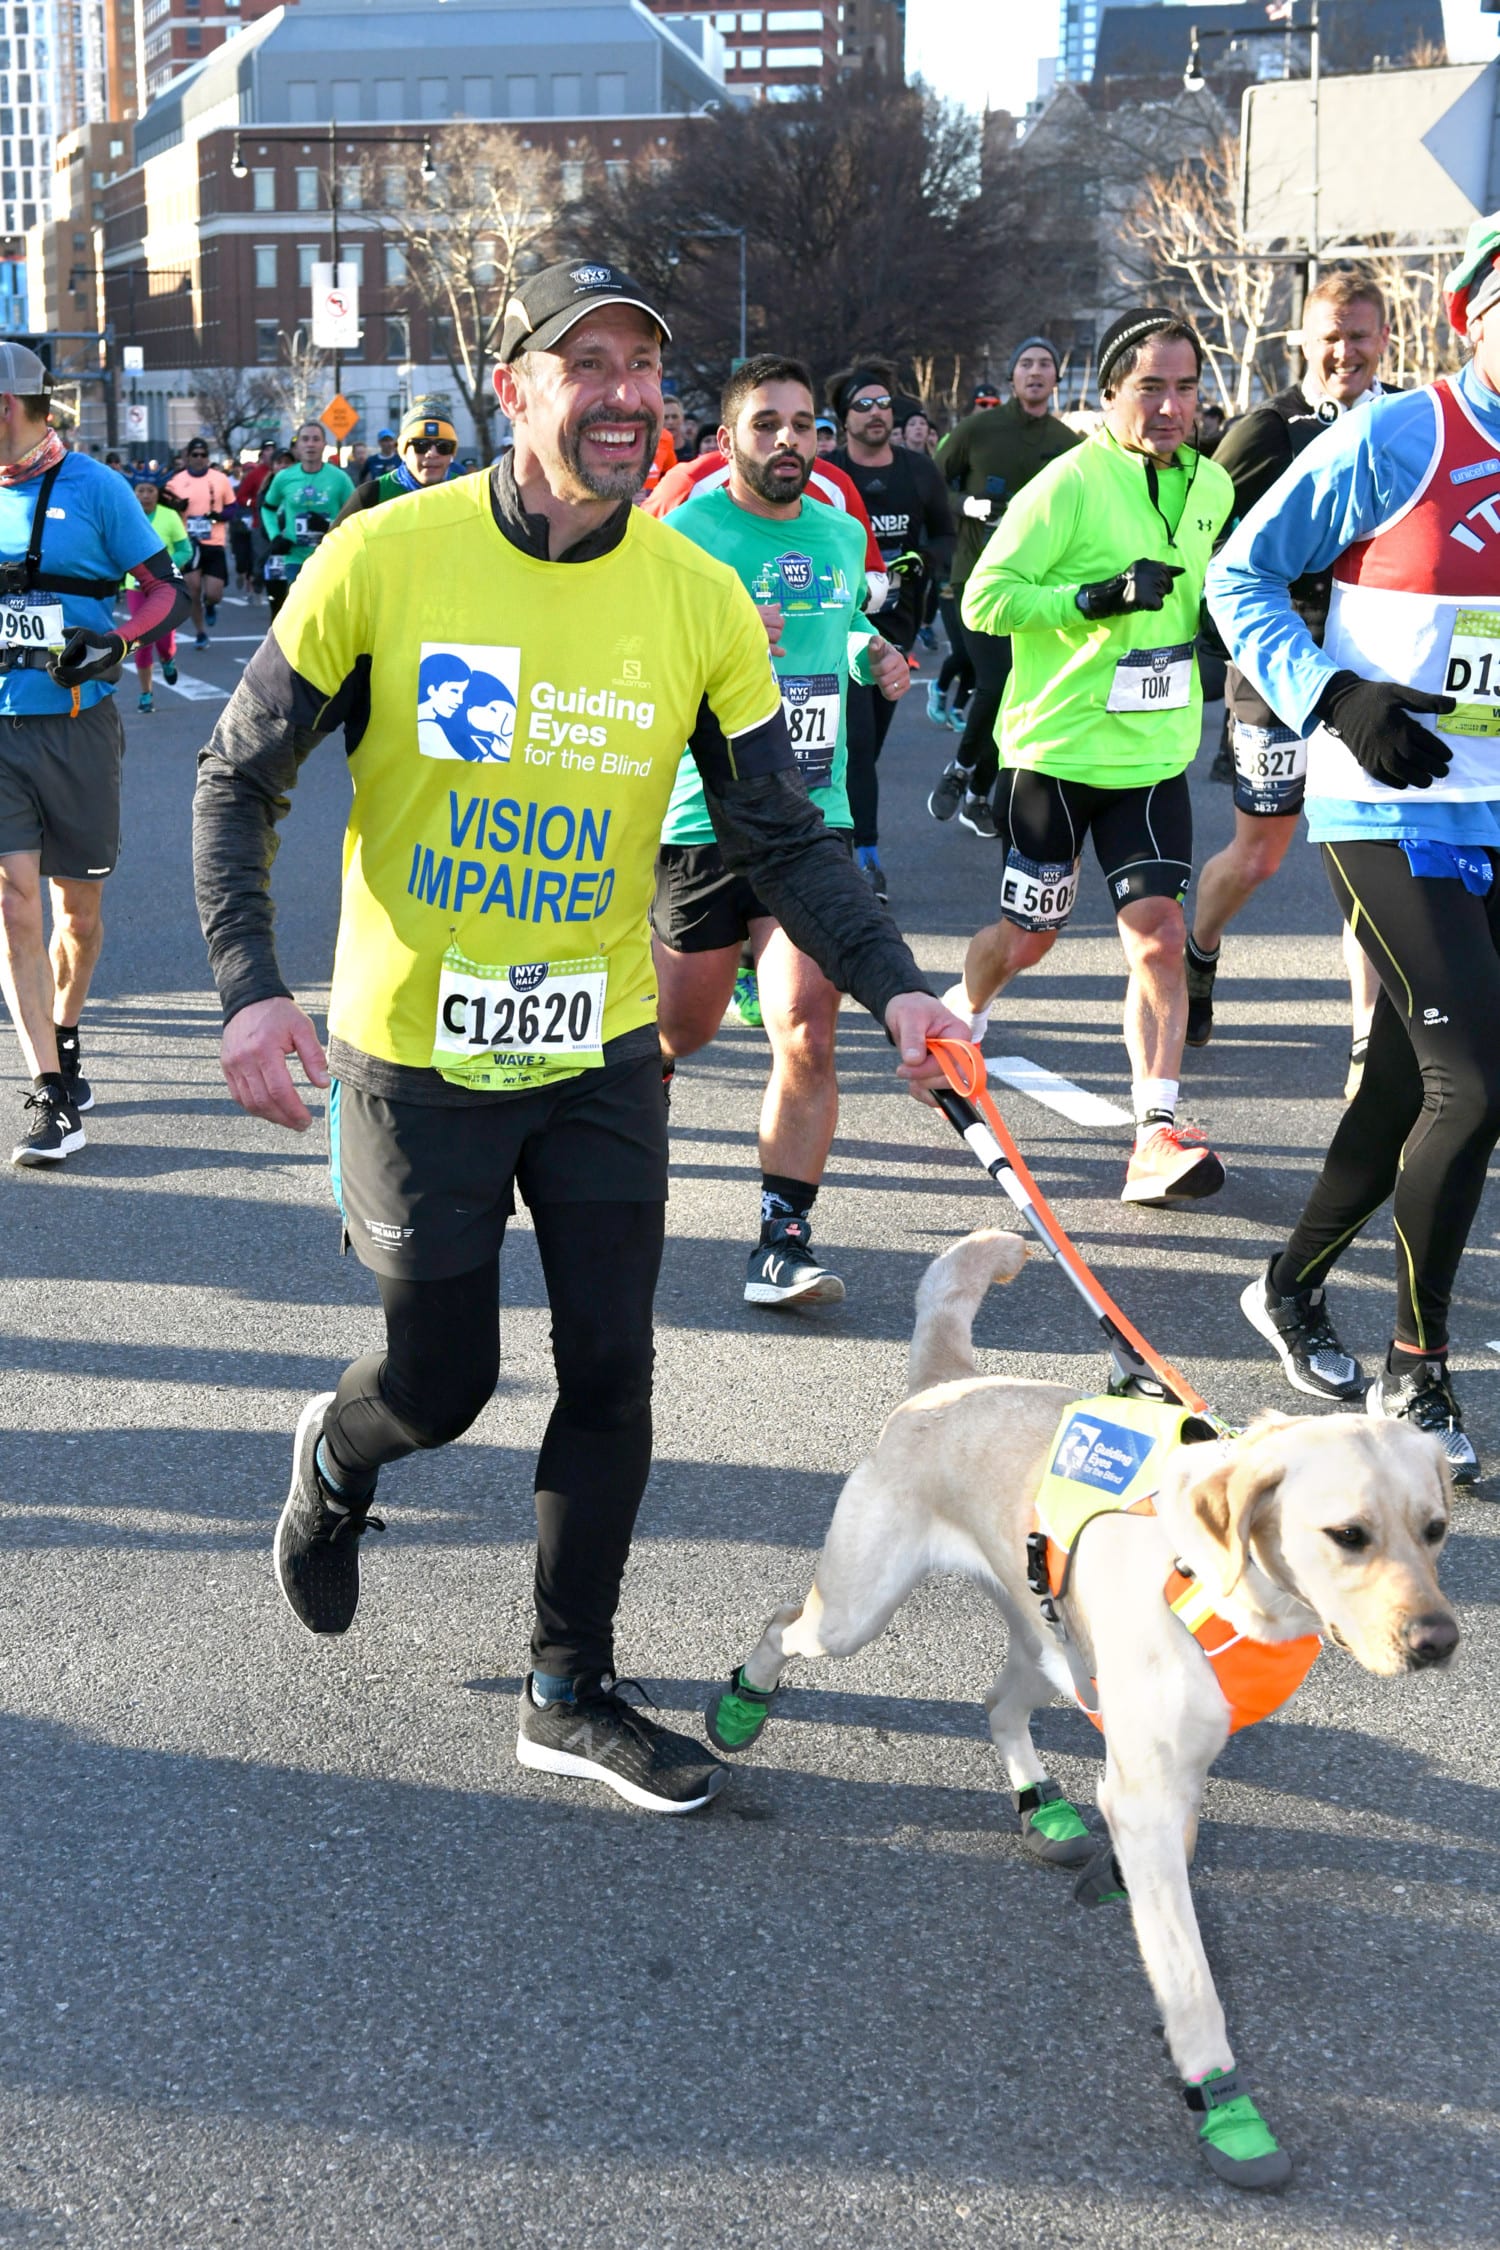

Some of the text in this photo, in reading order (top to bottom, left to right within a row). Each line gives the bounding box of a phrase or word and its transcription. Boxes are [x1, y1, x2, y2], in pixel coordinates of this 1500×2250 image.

[784, 564, 808, 575] NYC
[788, 575, 807, 583] HALF
[0, 612, 45, 641] 960
[789, 687, 809, 696] NYC
[1141, 676, 1171, 700] TOM
[530, 681, 656, 729] Guiding
[528, 711, 607, 747] Eyes
[789, 707, 826, 743] 871
[524, 743, 653, 777] for the Blind
[1253, 803, 1279, 813] 3827
[449, 789, 613, 861] VISION
[407, 842, 616, 924] IMPAIRED
[1043, 871, 1061, 879] NYC
[1003, 879, 1018, 905] E
[514, 963, 544, 978] NYC
[515, 976, 540, 987] HALF
[442, 991, 592, 1046] C12620
[493, 1054, 546, 1066] WAVE 2
[1087, 1452, 1113, 1469] Eyes
[1094, 1442, 1133, 1467] Guiding
